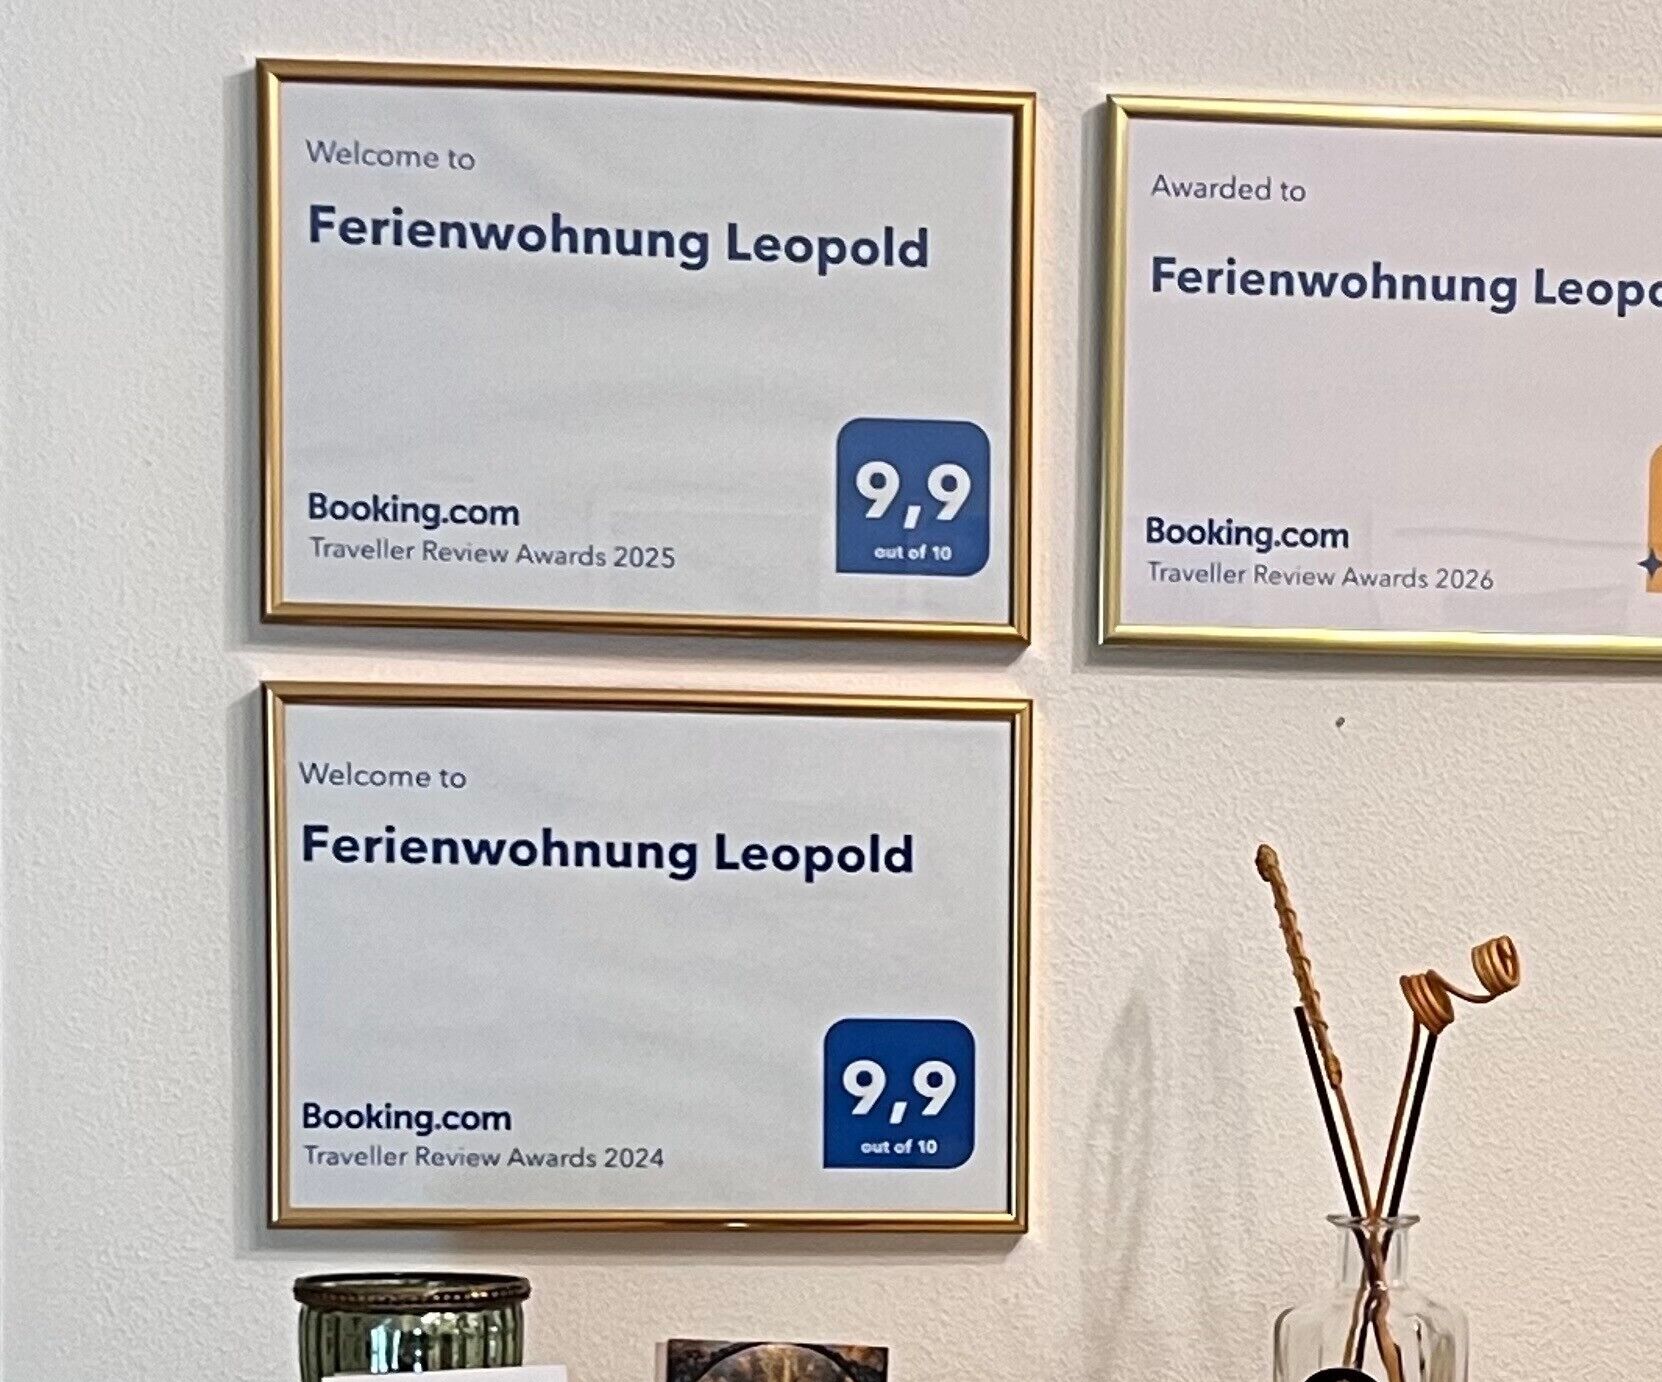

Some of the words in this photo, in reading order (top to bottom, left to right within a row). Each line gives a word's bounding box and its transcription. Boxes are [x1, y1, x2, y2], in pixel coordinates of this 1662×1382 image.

[305, 138, 440, 169] Welcome
[448, 149, 476, 171] to
[1151, 173, 1272, 201] Awarded
[1280, 181, 1307, 202] to
[309, 204, 709, 271] Ferienwohnung
[727, 222, 928, 277] Leopold
[1152, 256, 1518, 315] Ferienwohnung
[308, 492, 520, 531] Booking.com
[855, 460, 971, 530] 9,9
[874, 545, 905, 560] out
[907, 543, 927, 560] of
[932, 545, 953, 561] 10
[1146, 516, 1349, 554] Booking.com
[308, 536, 416, 561] Traveller
[422, 539, 509, 563] Review
[515, 543, 607, 567] Awards
[613, 545, 675, 569] 2025
[1147, 560, 1247, 585] Traveller
[1253, 563, 1336, 586] Review
[1341, 566, 1429, 589] Awards
[1435, 567, 1494, 591] 2026
[298, 761, 432, 789] Welcome
[438, 768, 467, 789] to
[303, 824, 697, 881] Ferienwohnung
[715, 832, 913, 884] Leopold
[842, 1059, 957, 1125] 9,9
[302, 1102, 512, 1137] Booking.com
[303, 1144, 409, 1167] Traveller
[415, 1145, 501, 1168] Review
[506, 1146, 597, 1168] Awards
[603, 1147, 664, 1169] 2024
[860, 1140, 890, 1154] out
[893, 1138, 914, 1154] of
[917, 1139, 938, 1154] 10
